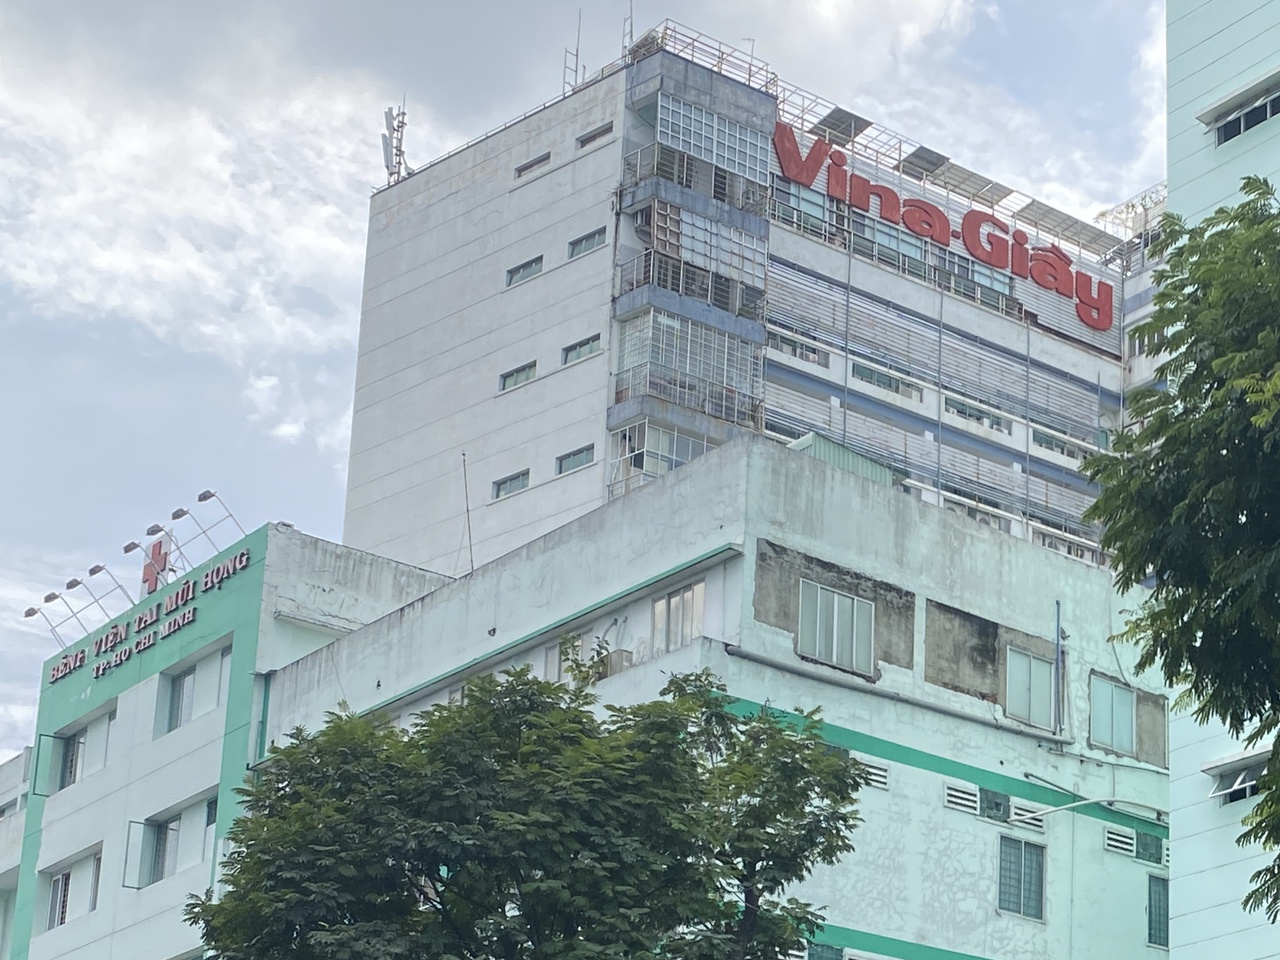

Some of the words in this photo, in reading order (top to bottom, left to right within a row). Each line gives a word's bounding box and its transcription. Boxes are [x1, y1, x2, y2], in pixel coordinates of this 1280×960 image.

[93, 621, 130, 658] VIỆN
[134, 602, 161, 634] TAI
[201, 548, 250, 593] HỌNG
[159, 606, 197, 640] MINH
